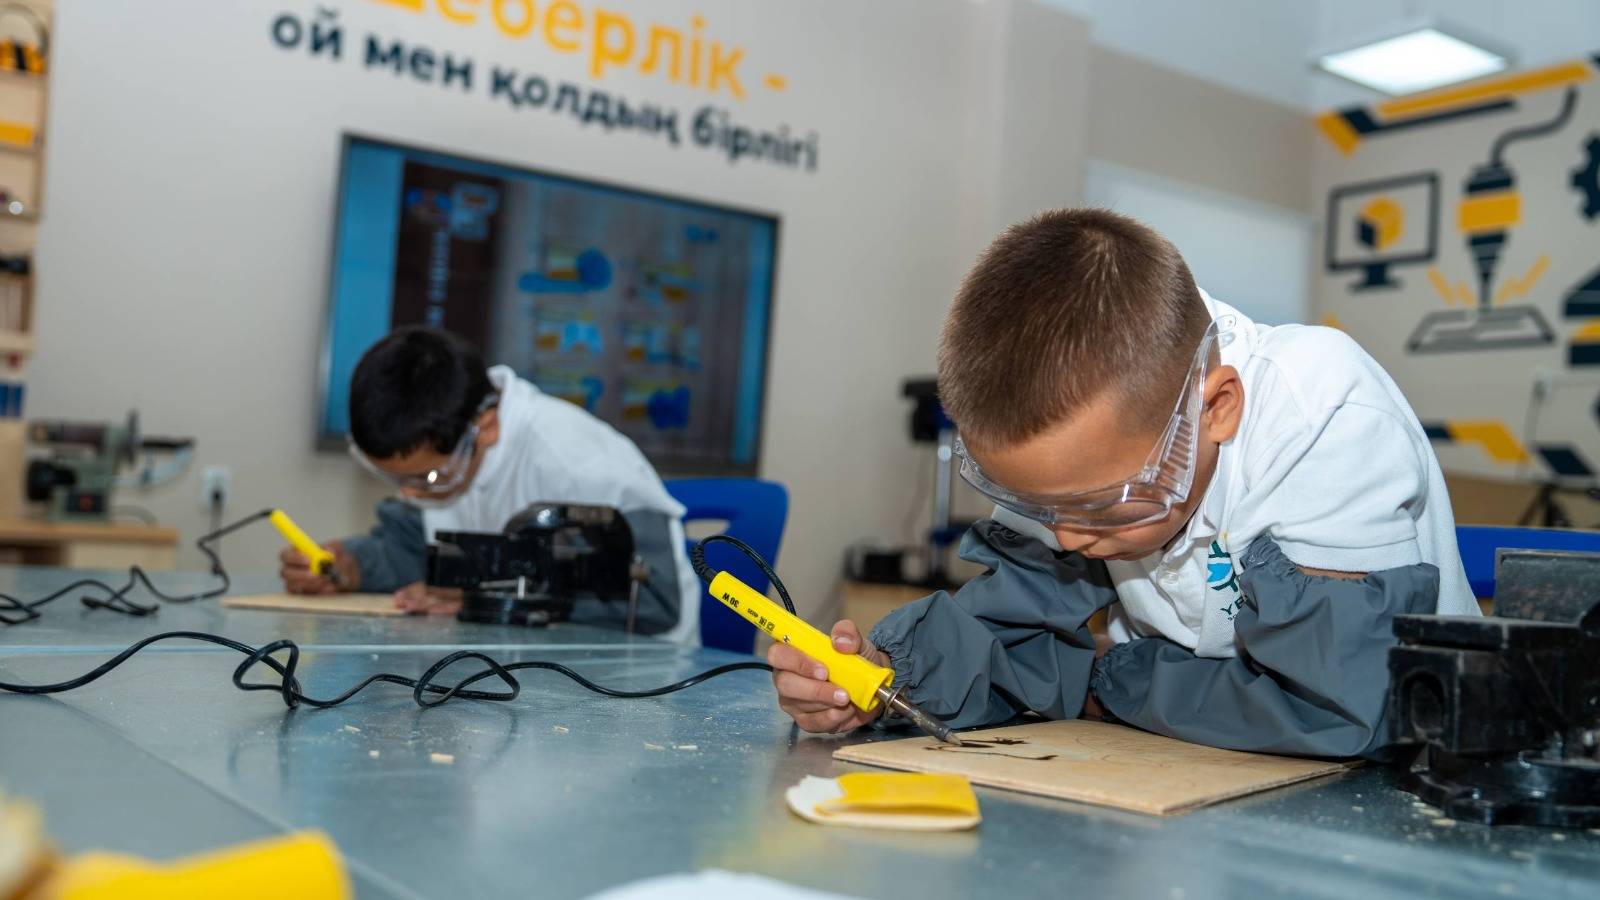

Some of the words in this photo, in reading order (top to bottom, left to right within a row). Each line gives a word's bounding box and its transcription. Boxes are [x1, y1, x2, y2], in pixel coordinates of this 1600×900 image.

[271, 6, 343, 61] ой
[363, 33, 474, 93] мен
[489, 66, 681, 147] қолдың
[691, 105, 819, 173] бірлігі
[364, 0, 747, 102] берлік
[729, 597, 740, 608] 30
